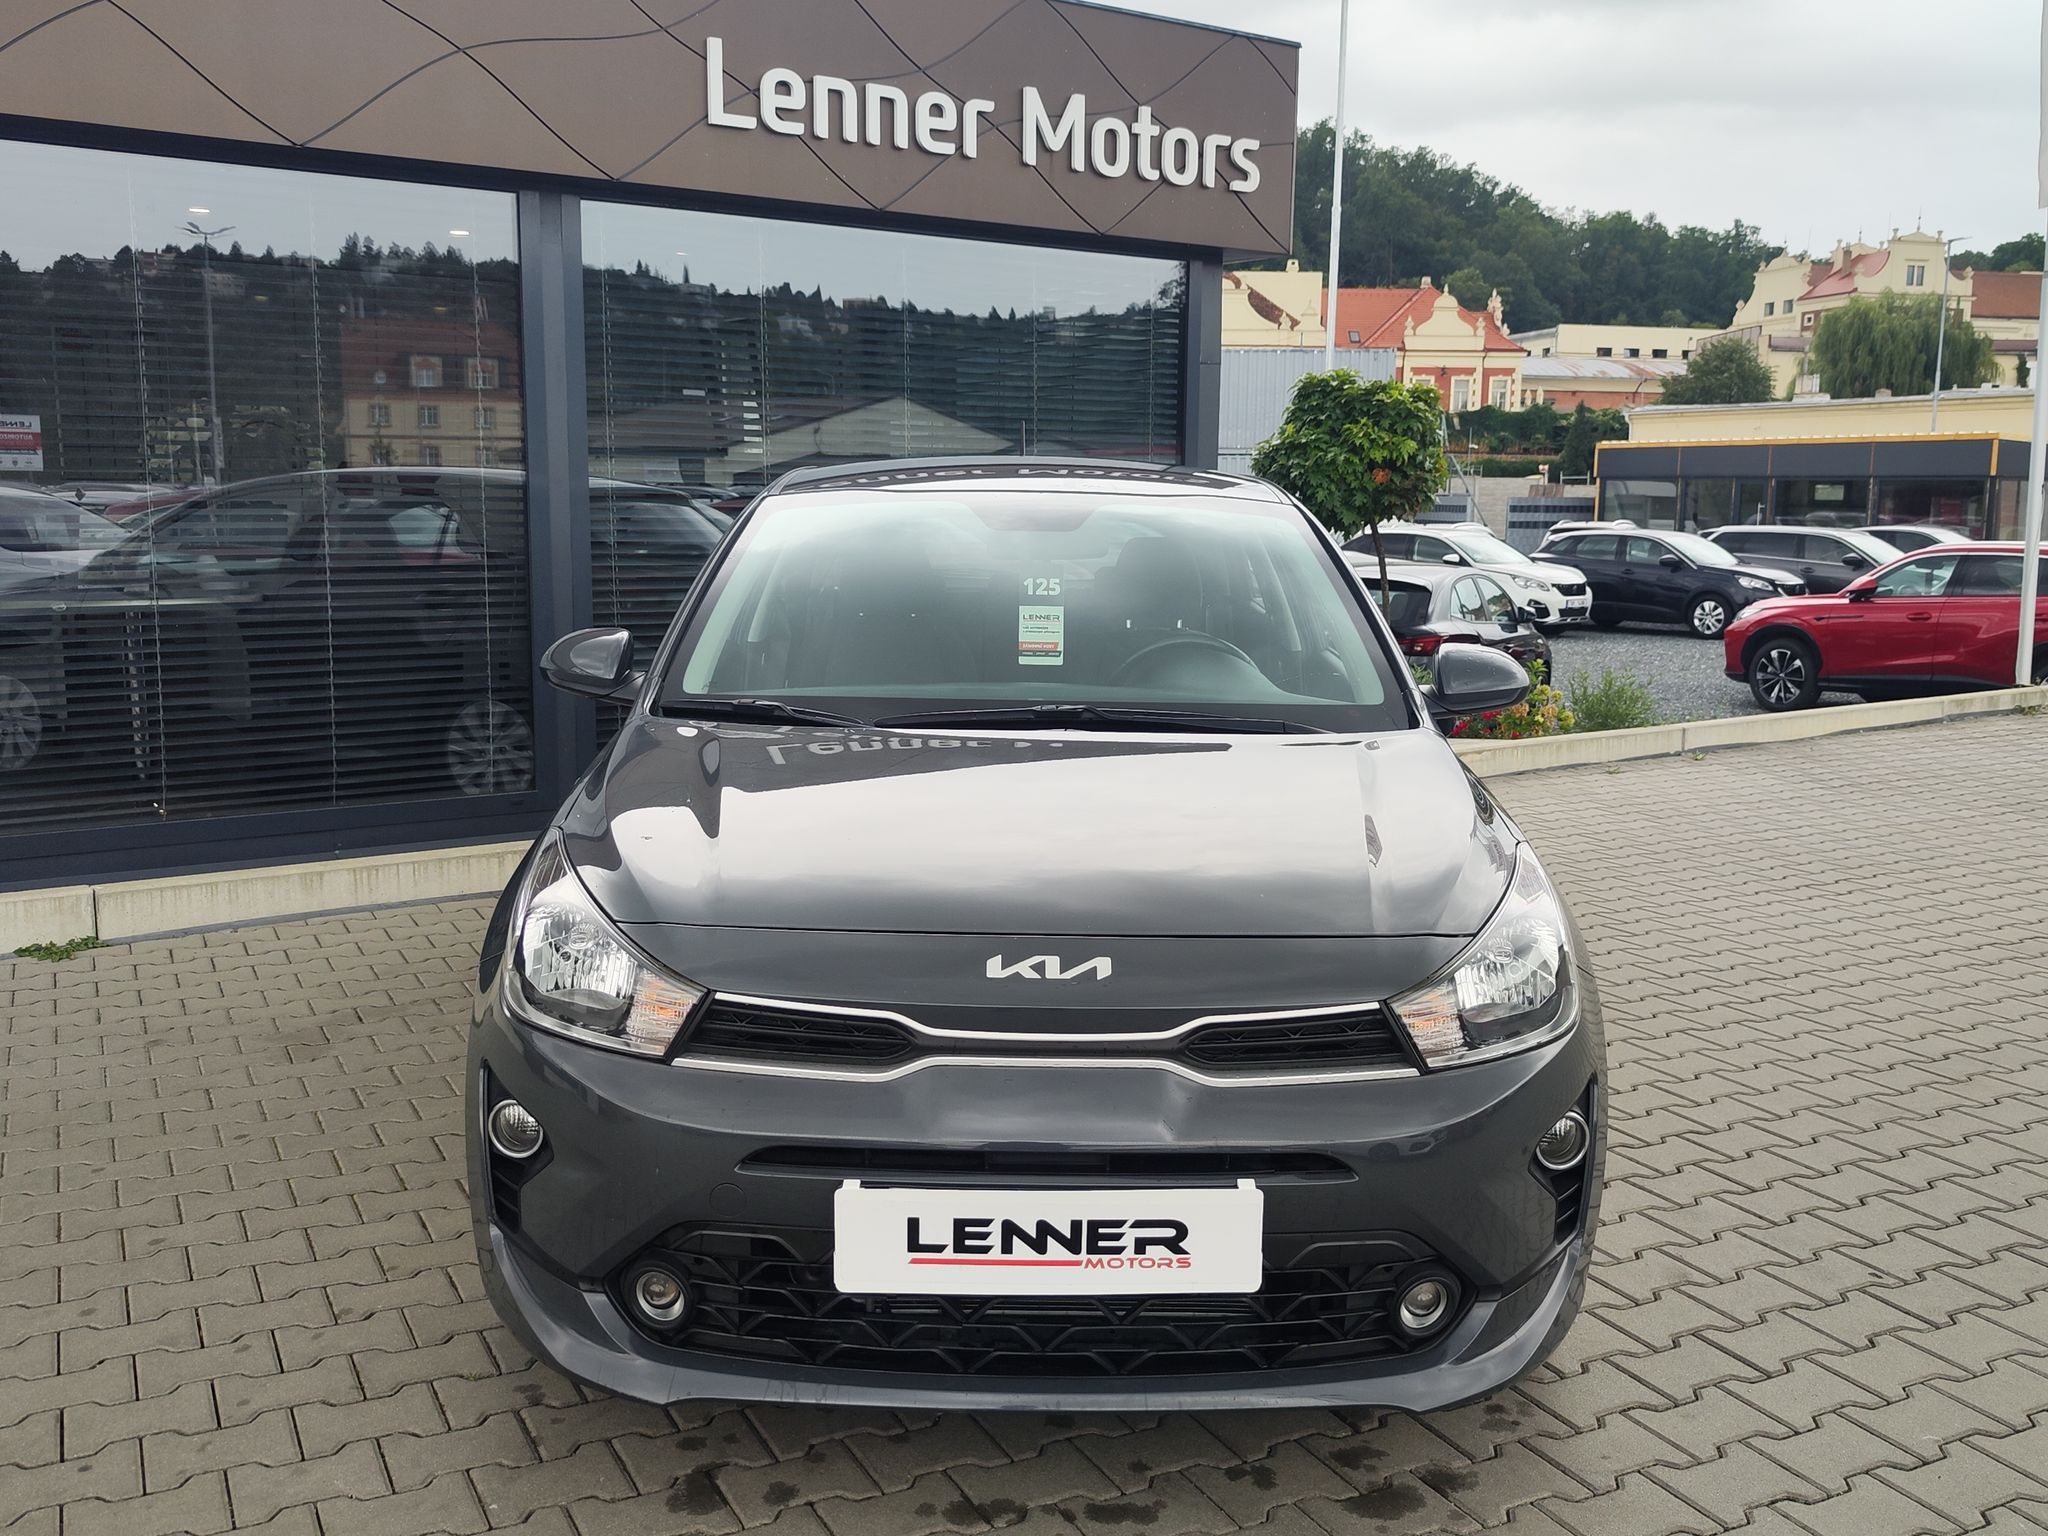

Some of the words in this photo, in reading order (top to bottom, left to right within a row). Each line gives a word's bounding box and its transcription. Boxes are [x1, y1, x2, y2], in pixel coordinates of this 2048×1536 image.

[706, 36, 995, 160] Lenner
[1022, 85, 1261, 194] Motors
[1023, 577, 1061, 596] 125
[986, 954, 1112, 980] KIA
[907, 1217, 1191, 1256] LENNER
[1083, 1256, 1192, 1270] MOTORS
